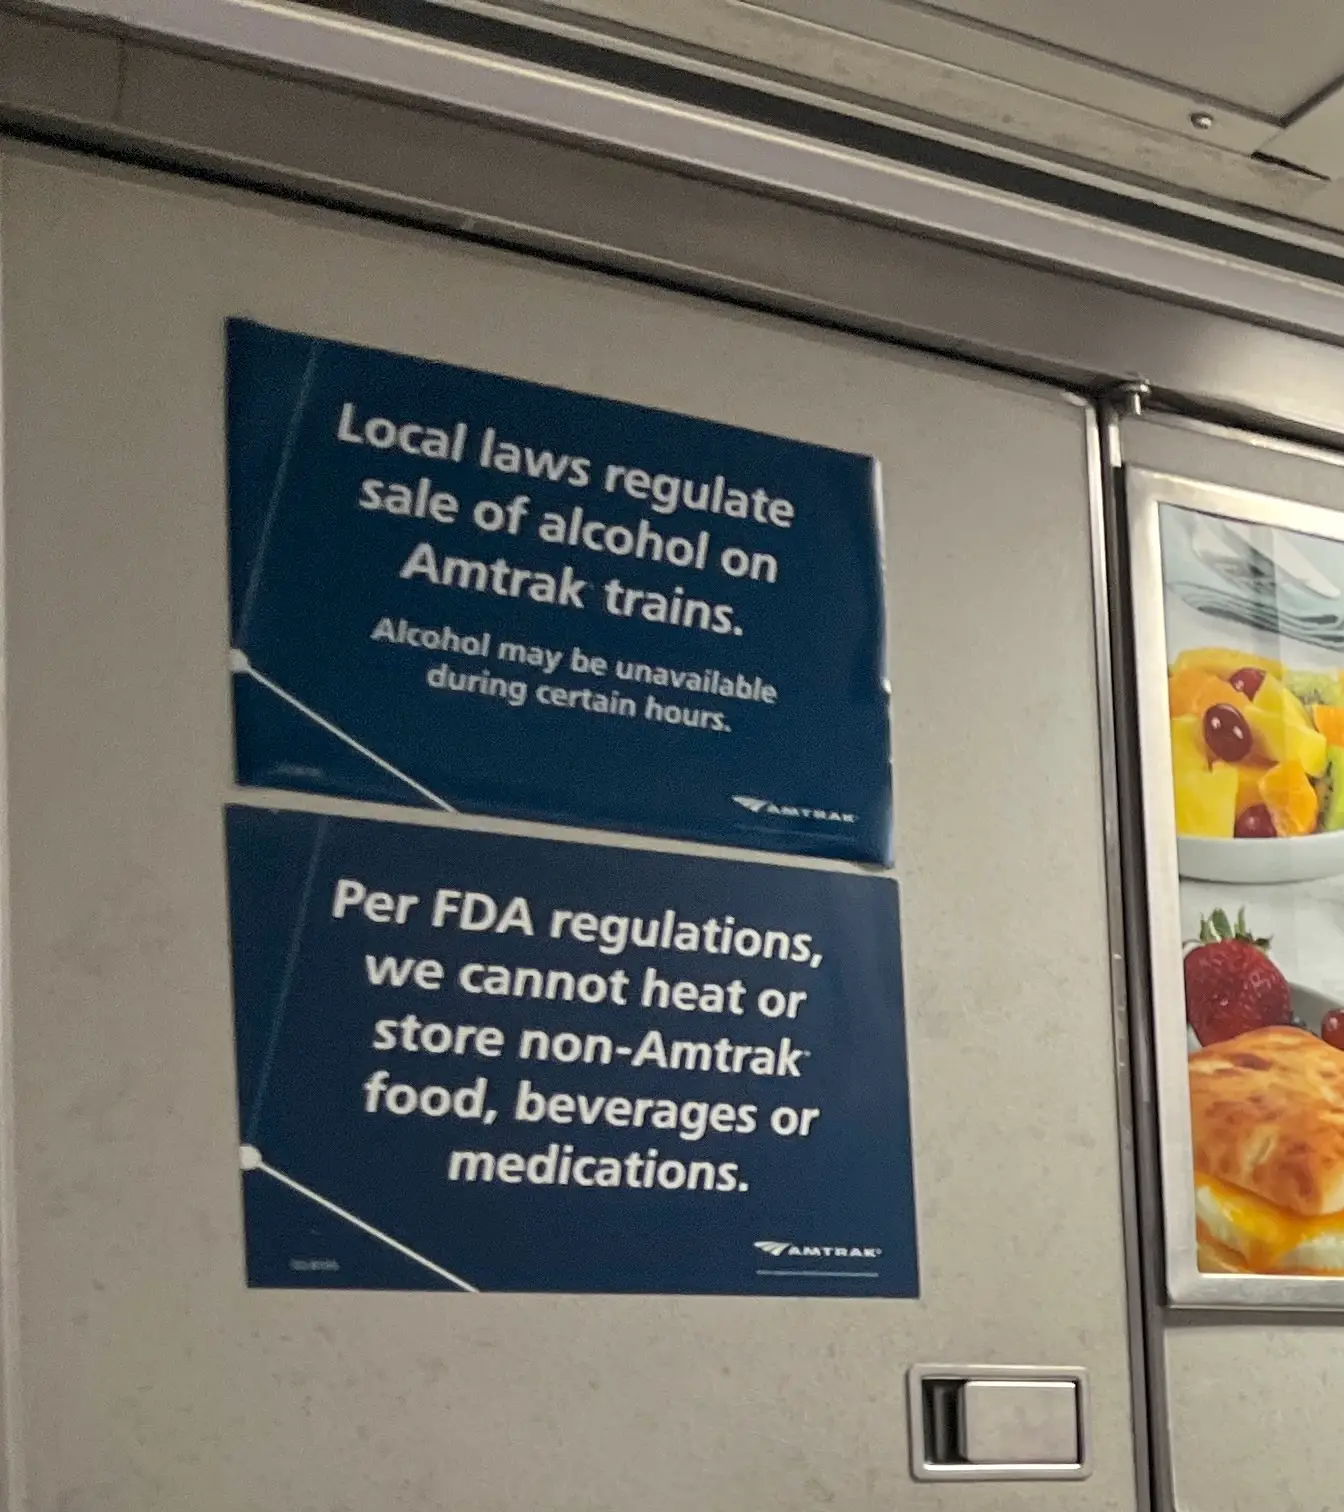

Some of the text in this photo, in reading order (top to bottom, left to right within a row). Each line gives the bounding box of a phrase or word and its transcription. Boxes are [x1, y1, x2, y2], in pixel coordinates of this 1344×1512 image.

[335, 402, 796, 529] Local laws regulate
[359, 477, 778, 584] sale of alcohol on
[399, 543, 744, 636] Amtrak trains.
[369, 616, 778, 705] Alcohol may be unavailable
[426, 662, 732, 733] during certain hours.
[766, 803, 855, 824] AMTRAK
[332, 878, 824, 969] Per FDA regulations,
[364, 954, 807, 1020] we cannot heat or
[373, 1015, 803, 1077] store non-Amtrak
[363, 1072, 820, 1141] food, beverages or
[446, 1144, 750, 1193] medications.
[787, 1243, 877, 1259] AMTRAK
